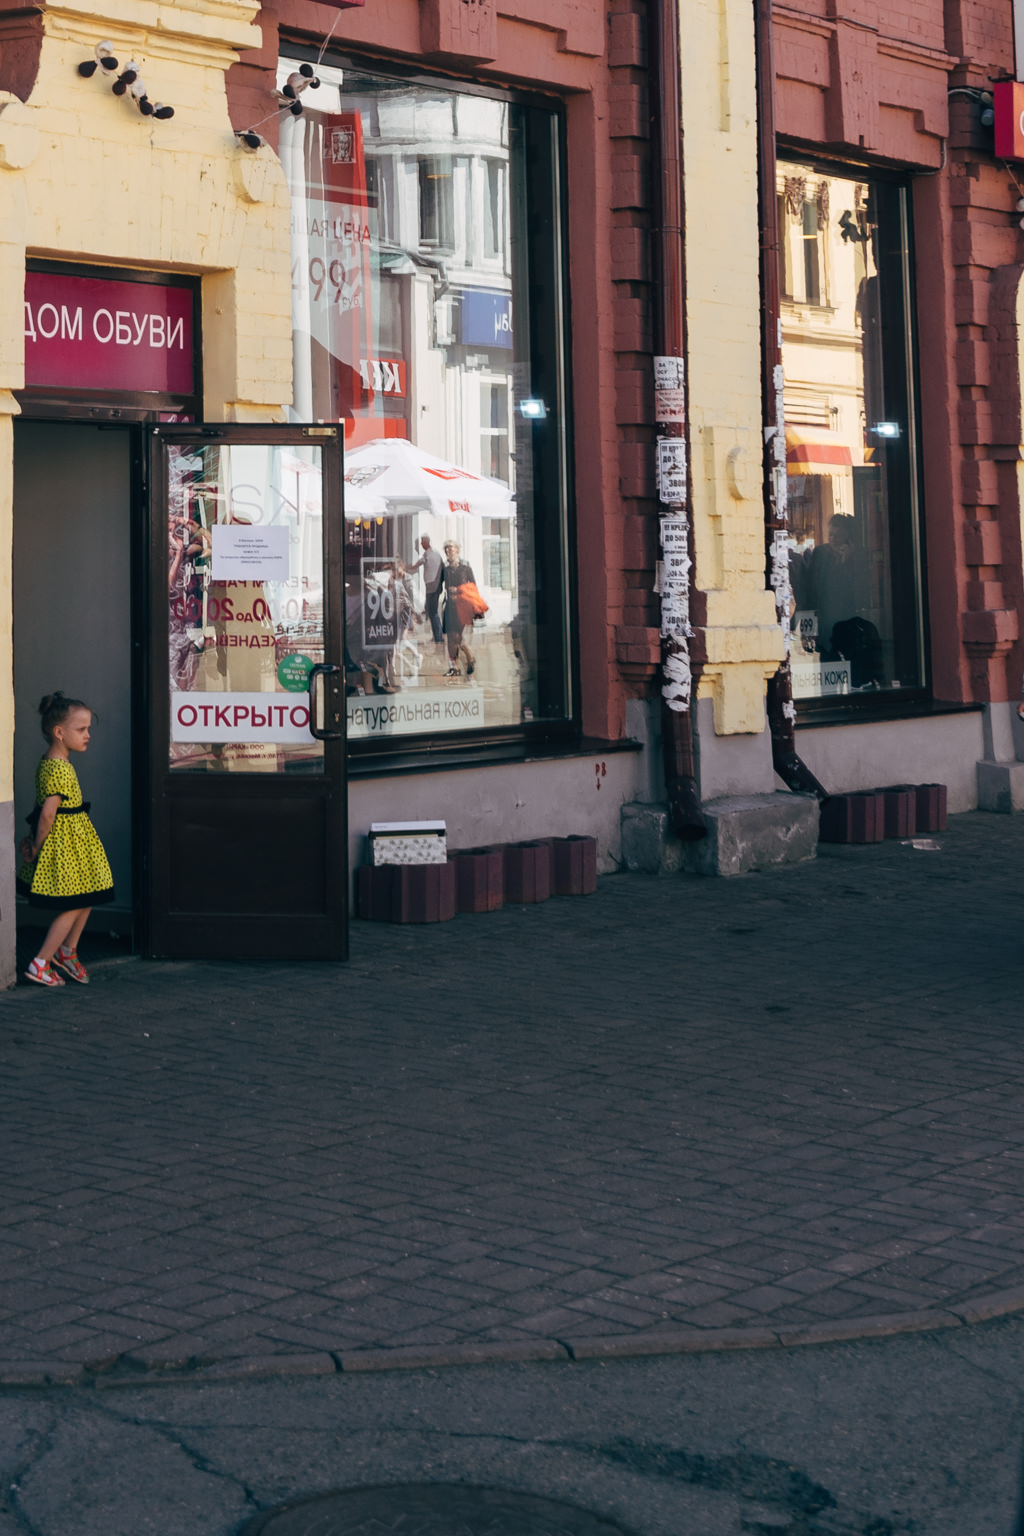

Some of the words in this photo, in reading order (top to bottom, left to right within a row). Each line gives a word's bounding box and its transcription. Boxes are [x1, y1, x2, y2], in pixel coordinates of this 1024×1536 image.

[332, 220, 372, 242] ЦЕНА
[24, 301, 83, 343] ДОМ
[92, 308, 185, 350] ОБУВИ
[367, 590, 394, 620] 90
[368, 622, 394, 639] ДНЕЙ
[824, 669, 849, 686] кожа
[177, 704, 310, 728] ОТКРЫТО
[347, 702, 441, 731] натуральная
[444, 699, 480, 719] кожа
